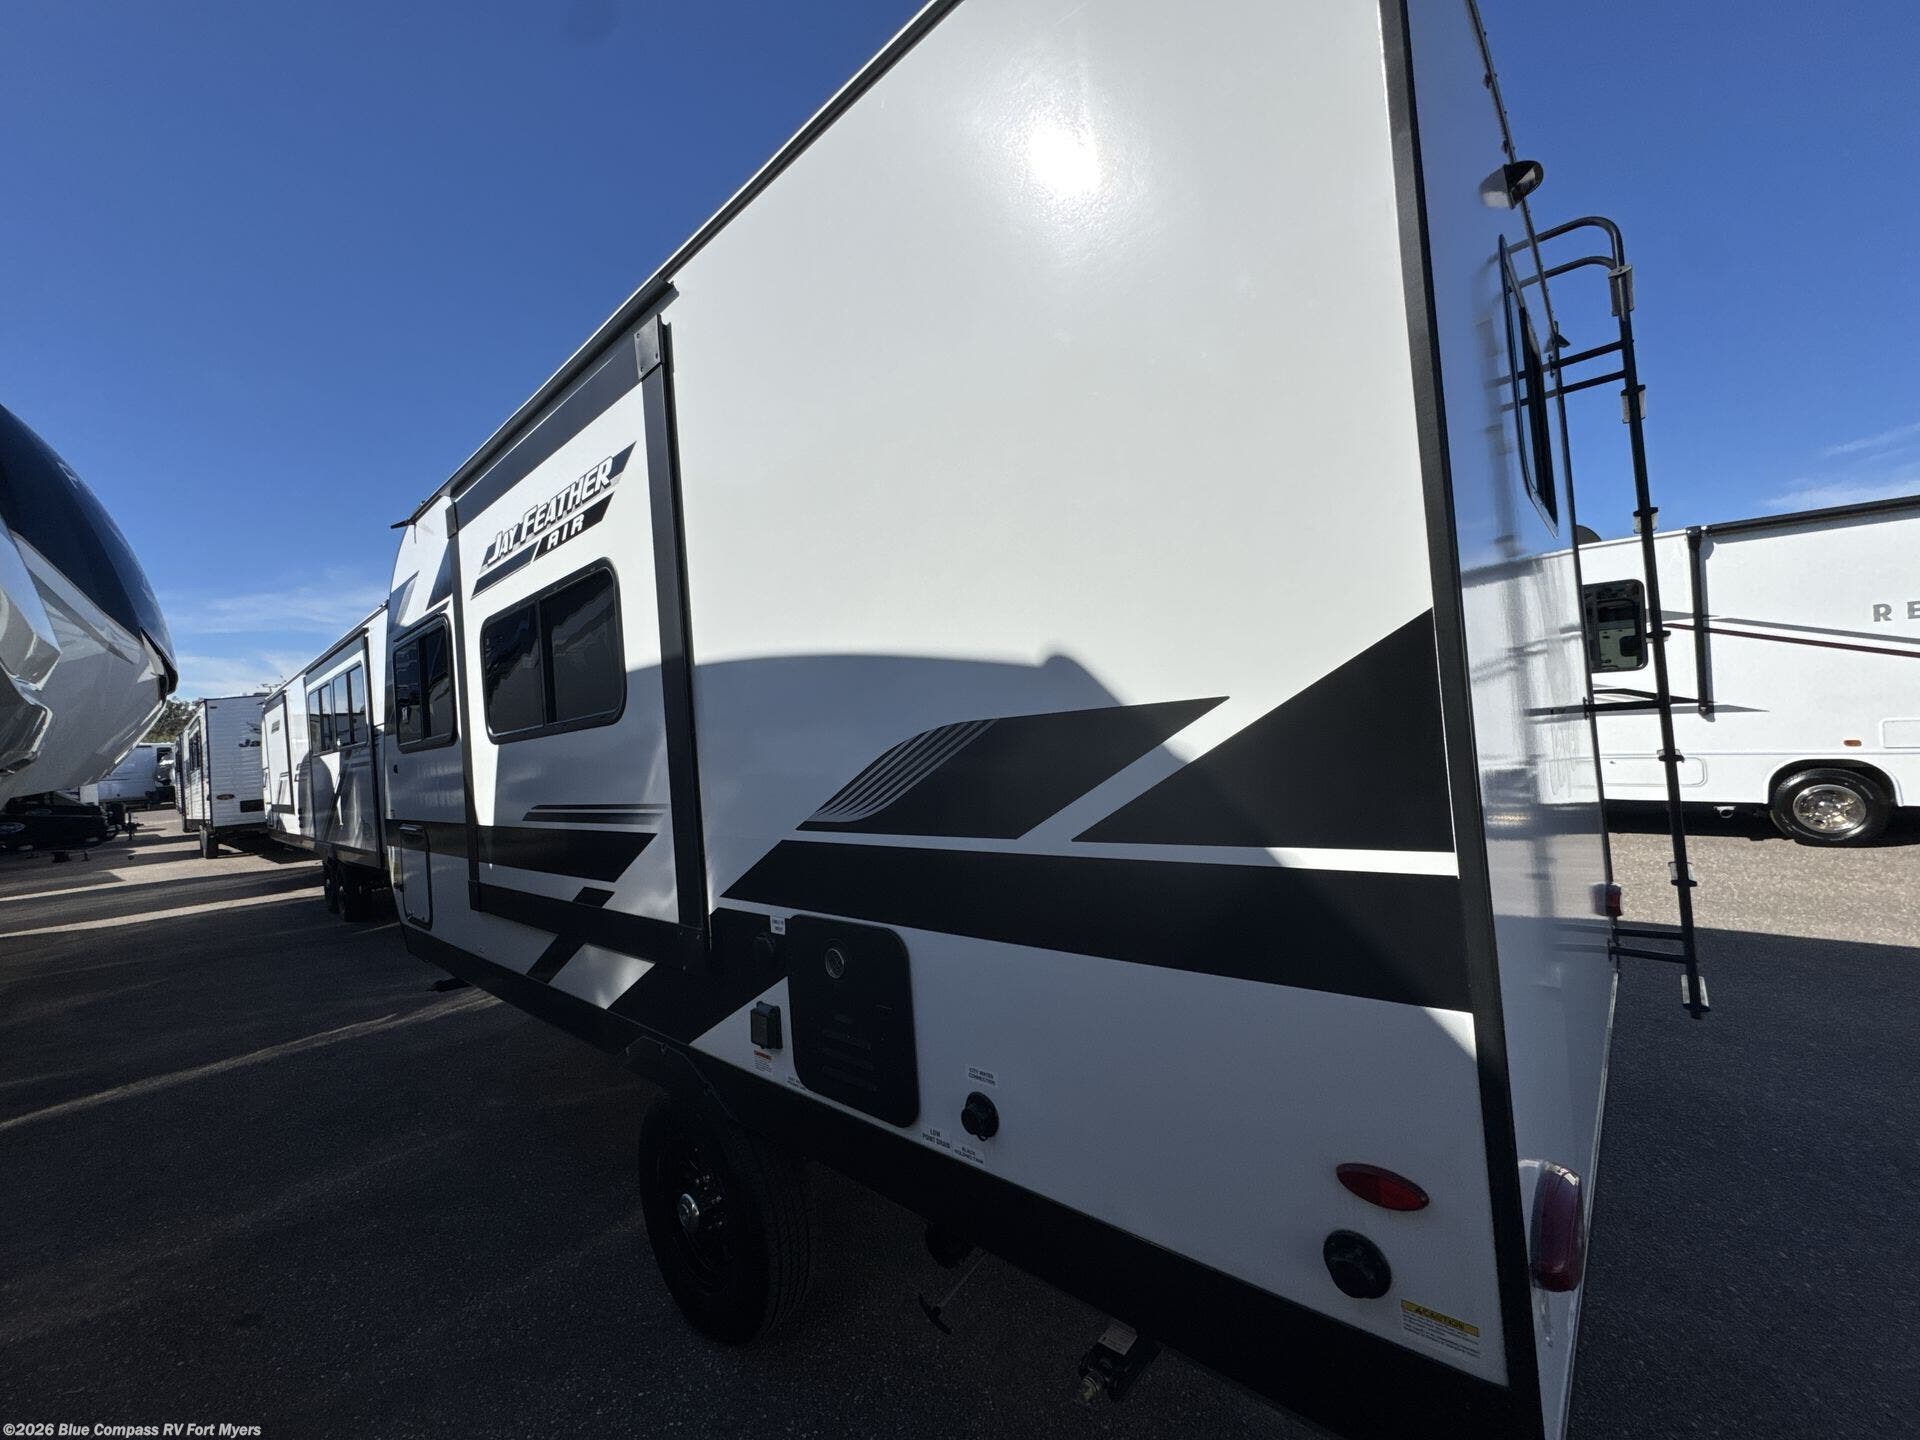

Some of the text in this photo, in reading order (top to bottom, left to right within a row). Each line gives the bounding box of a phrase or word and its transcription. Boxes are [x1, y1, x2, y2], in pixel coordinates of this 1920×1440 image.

[487, 456, 614, 567] JAY FEATHER
[547, 514, 585, 550] AIR
[930, 1129, 940, 1137] LOW
